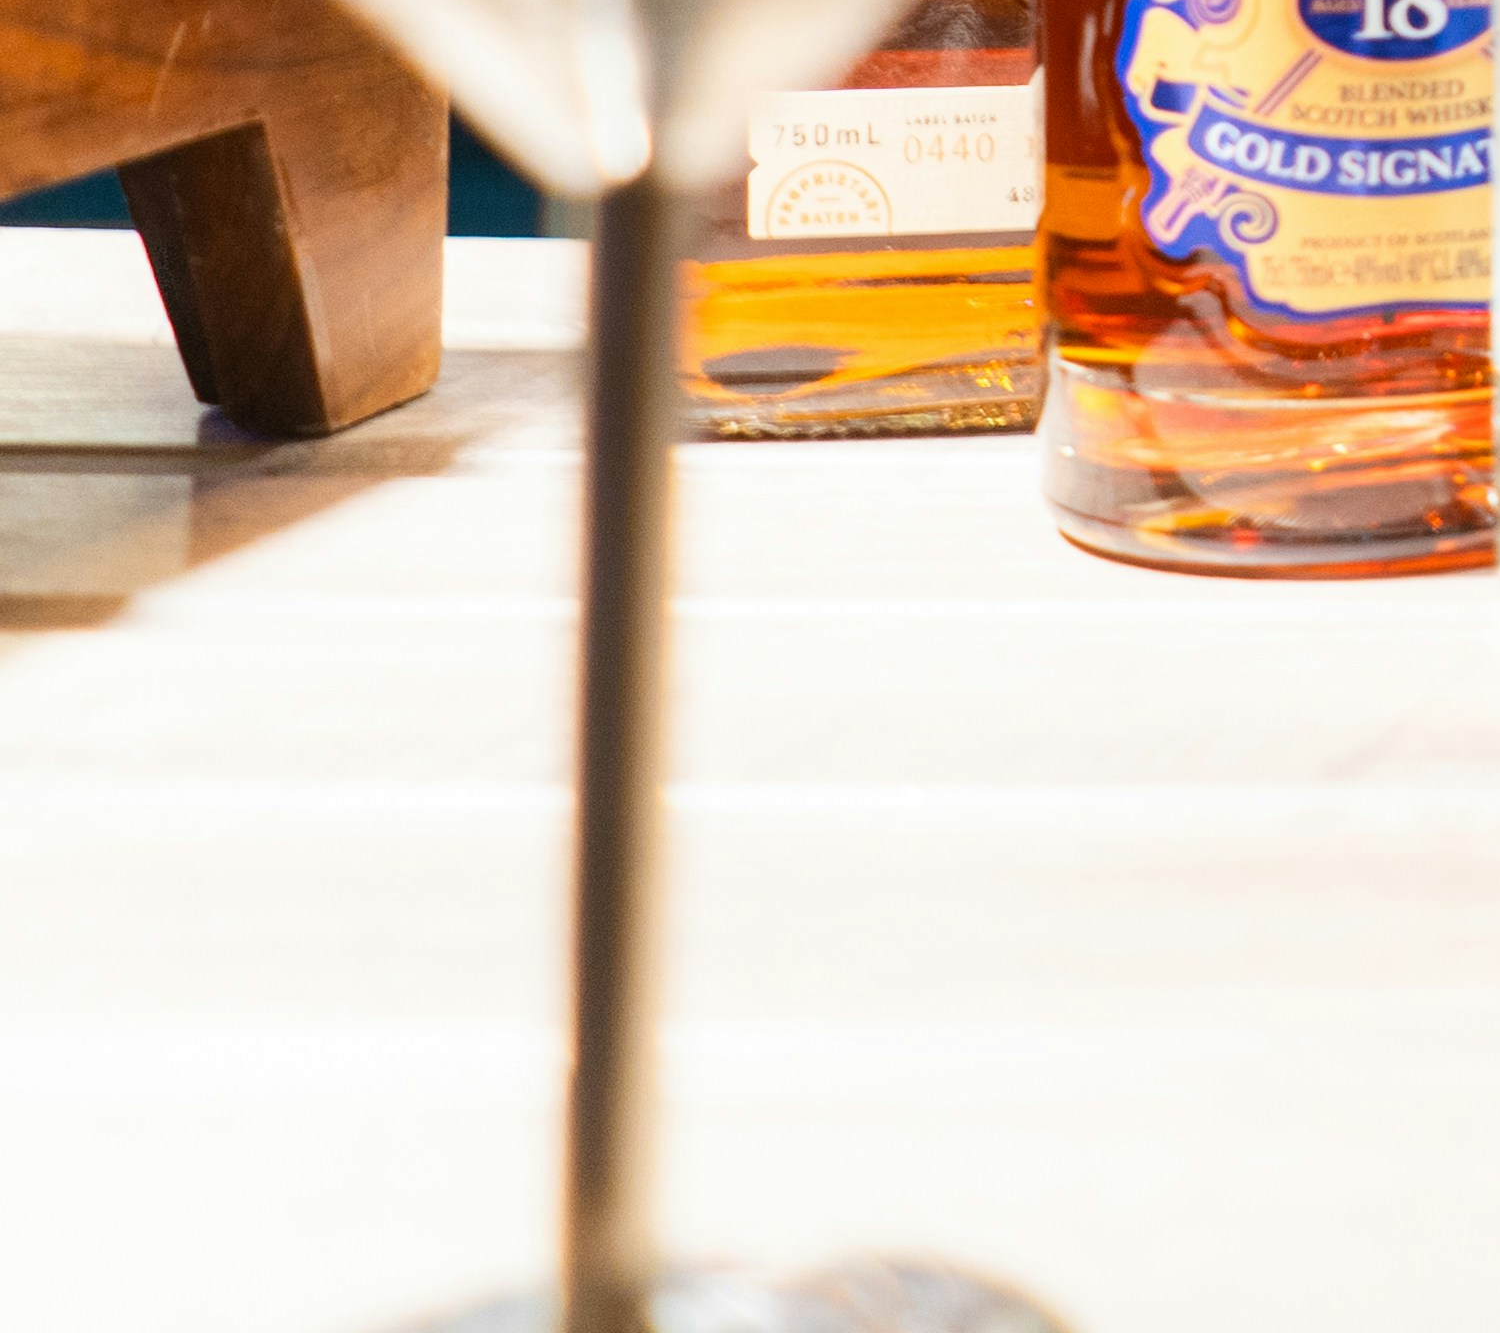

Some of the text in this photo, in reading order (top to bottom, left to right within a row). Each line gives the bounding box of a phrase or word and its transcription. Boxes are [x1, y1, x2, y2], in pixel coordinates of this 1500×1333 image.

[1338, 79, 1465, 104] BLENDED
[905, 113, 998, 126] LABEL BATCH
[1292, 102, 1397, 129] SCOTCH
[772, 123, 881, 148] 750mL
[903, 132, 997, 165] 0440
[1204, 121, 1331, 185] GOLD
[777, 170, 883, 227] PROPRIETARY
[800, 211, 861, 226] BATCH
